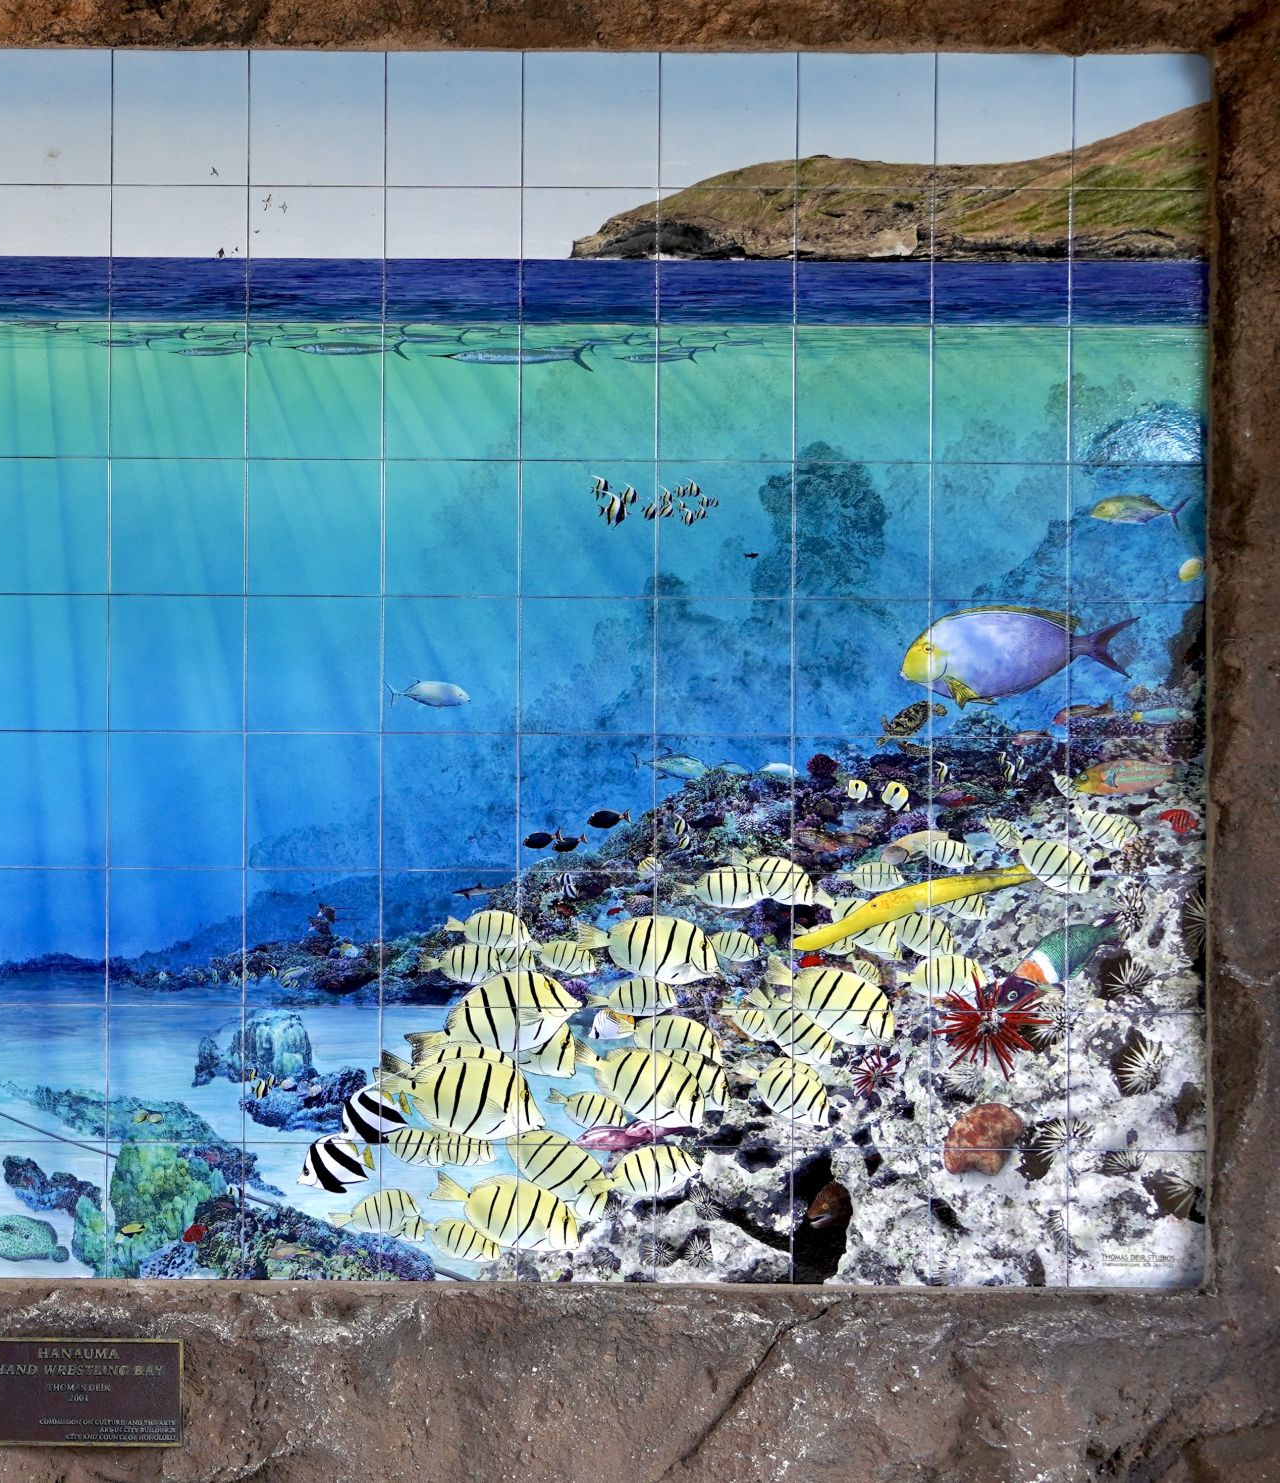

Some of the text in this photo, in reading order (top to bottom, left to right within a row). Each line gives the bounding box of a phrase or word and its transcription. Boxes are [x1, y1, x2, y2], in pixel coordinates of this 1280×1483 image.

[1101, 1253, 1129, 1261] THOMAS
[1148, 1254, 1176, 1262] STUDIOS
[37, 1347, 120, 1359] HANAUMA
[43, 1364, 129, 1377] WRESTLING
[133, 1365, 166, 1377] BAY
[48, 1383, 87, 1392] THOMAS
[68, 1394, 88, 1402] 2001
